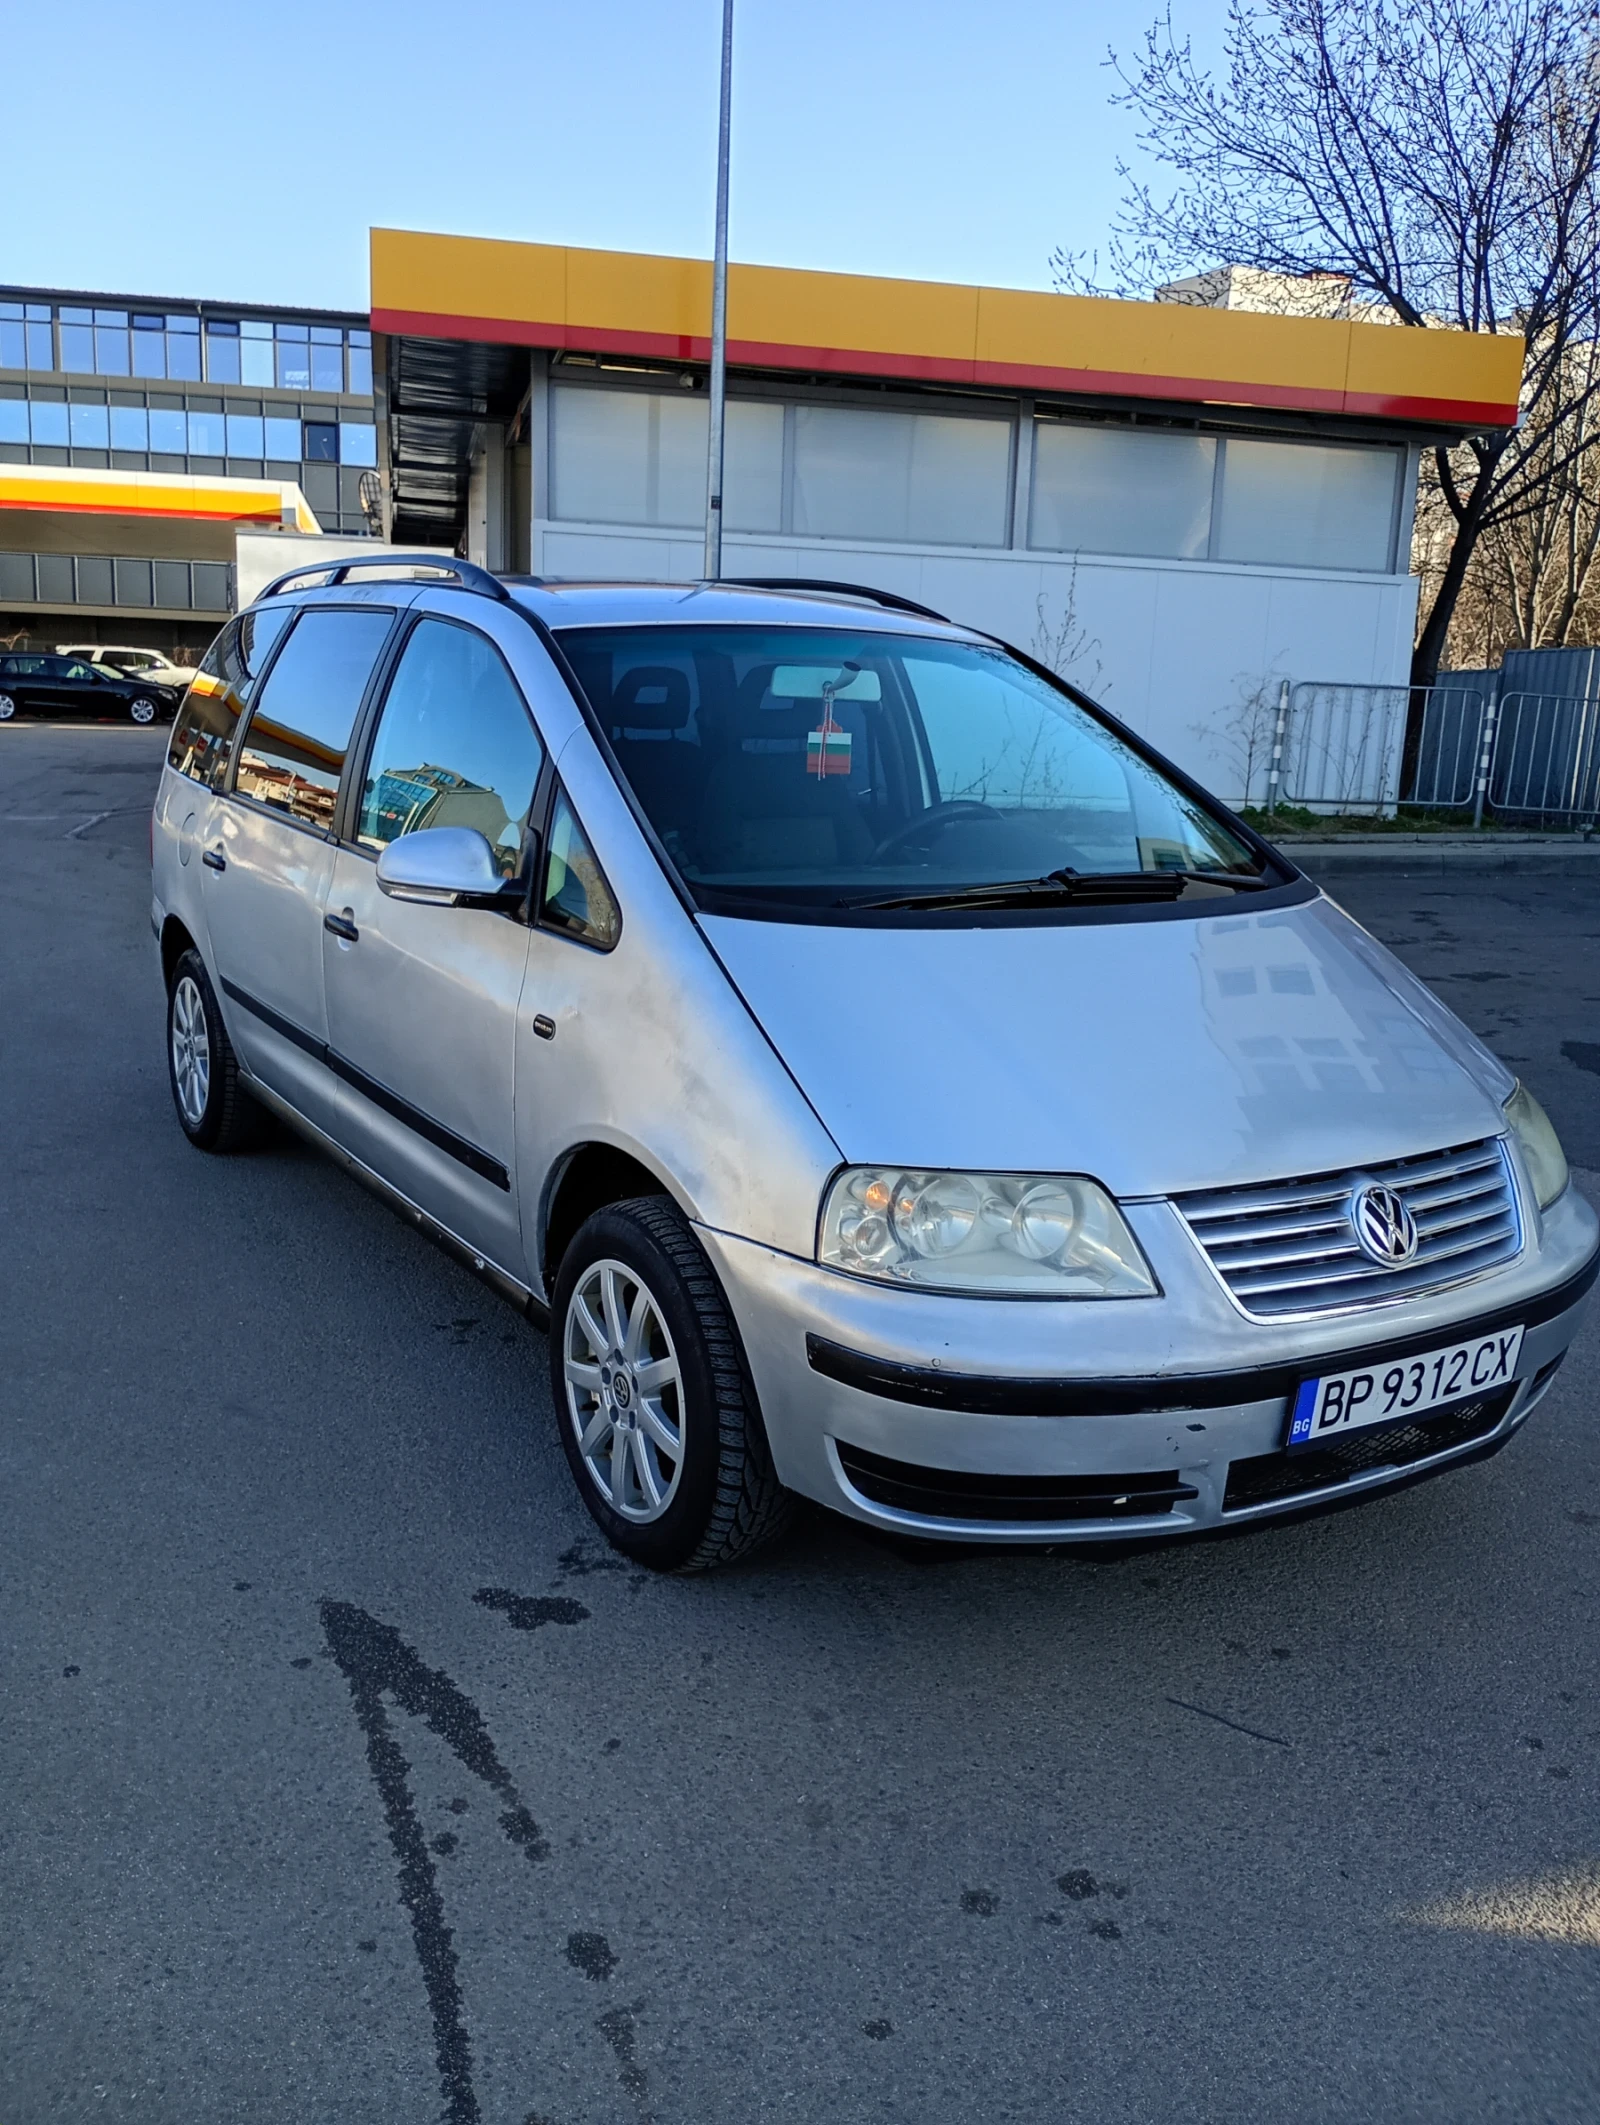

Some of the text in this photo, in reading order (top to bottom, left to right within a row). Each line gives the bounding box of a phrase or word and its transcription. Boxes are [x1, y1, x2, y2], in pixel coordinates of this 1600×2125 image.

[1355, 1184, 1415, 1265] VW
[1292, 1418, 1310, 1435] BG
[1319, 1374, 1374, 1429] BP
[1382, 1350, 1468, 1414] 9312
